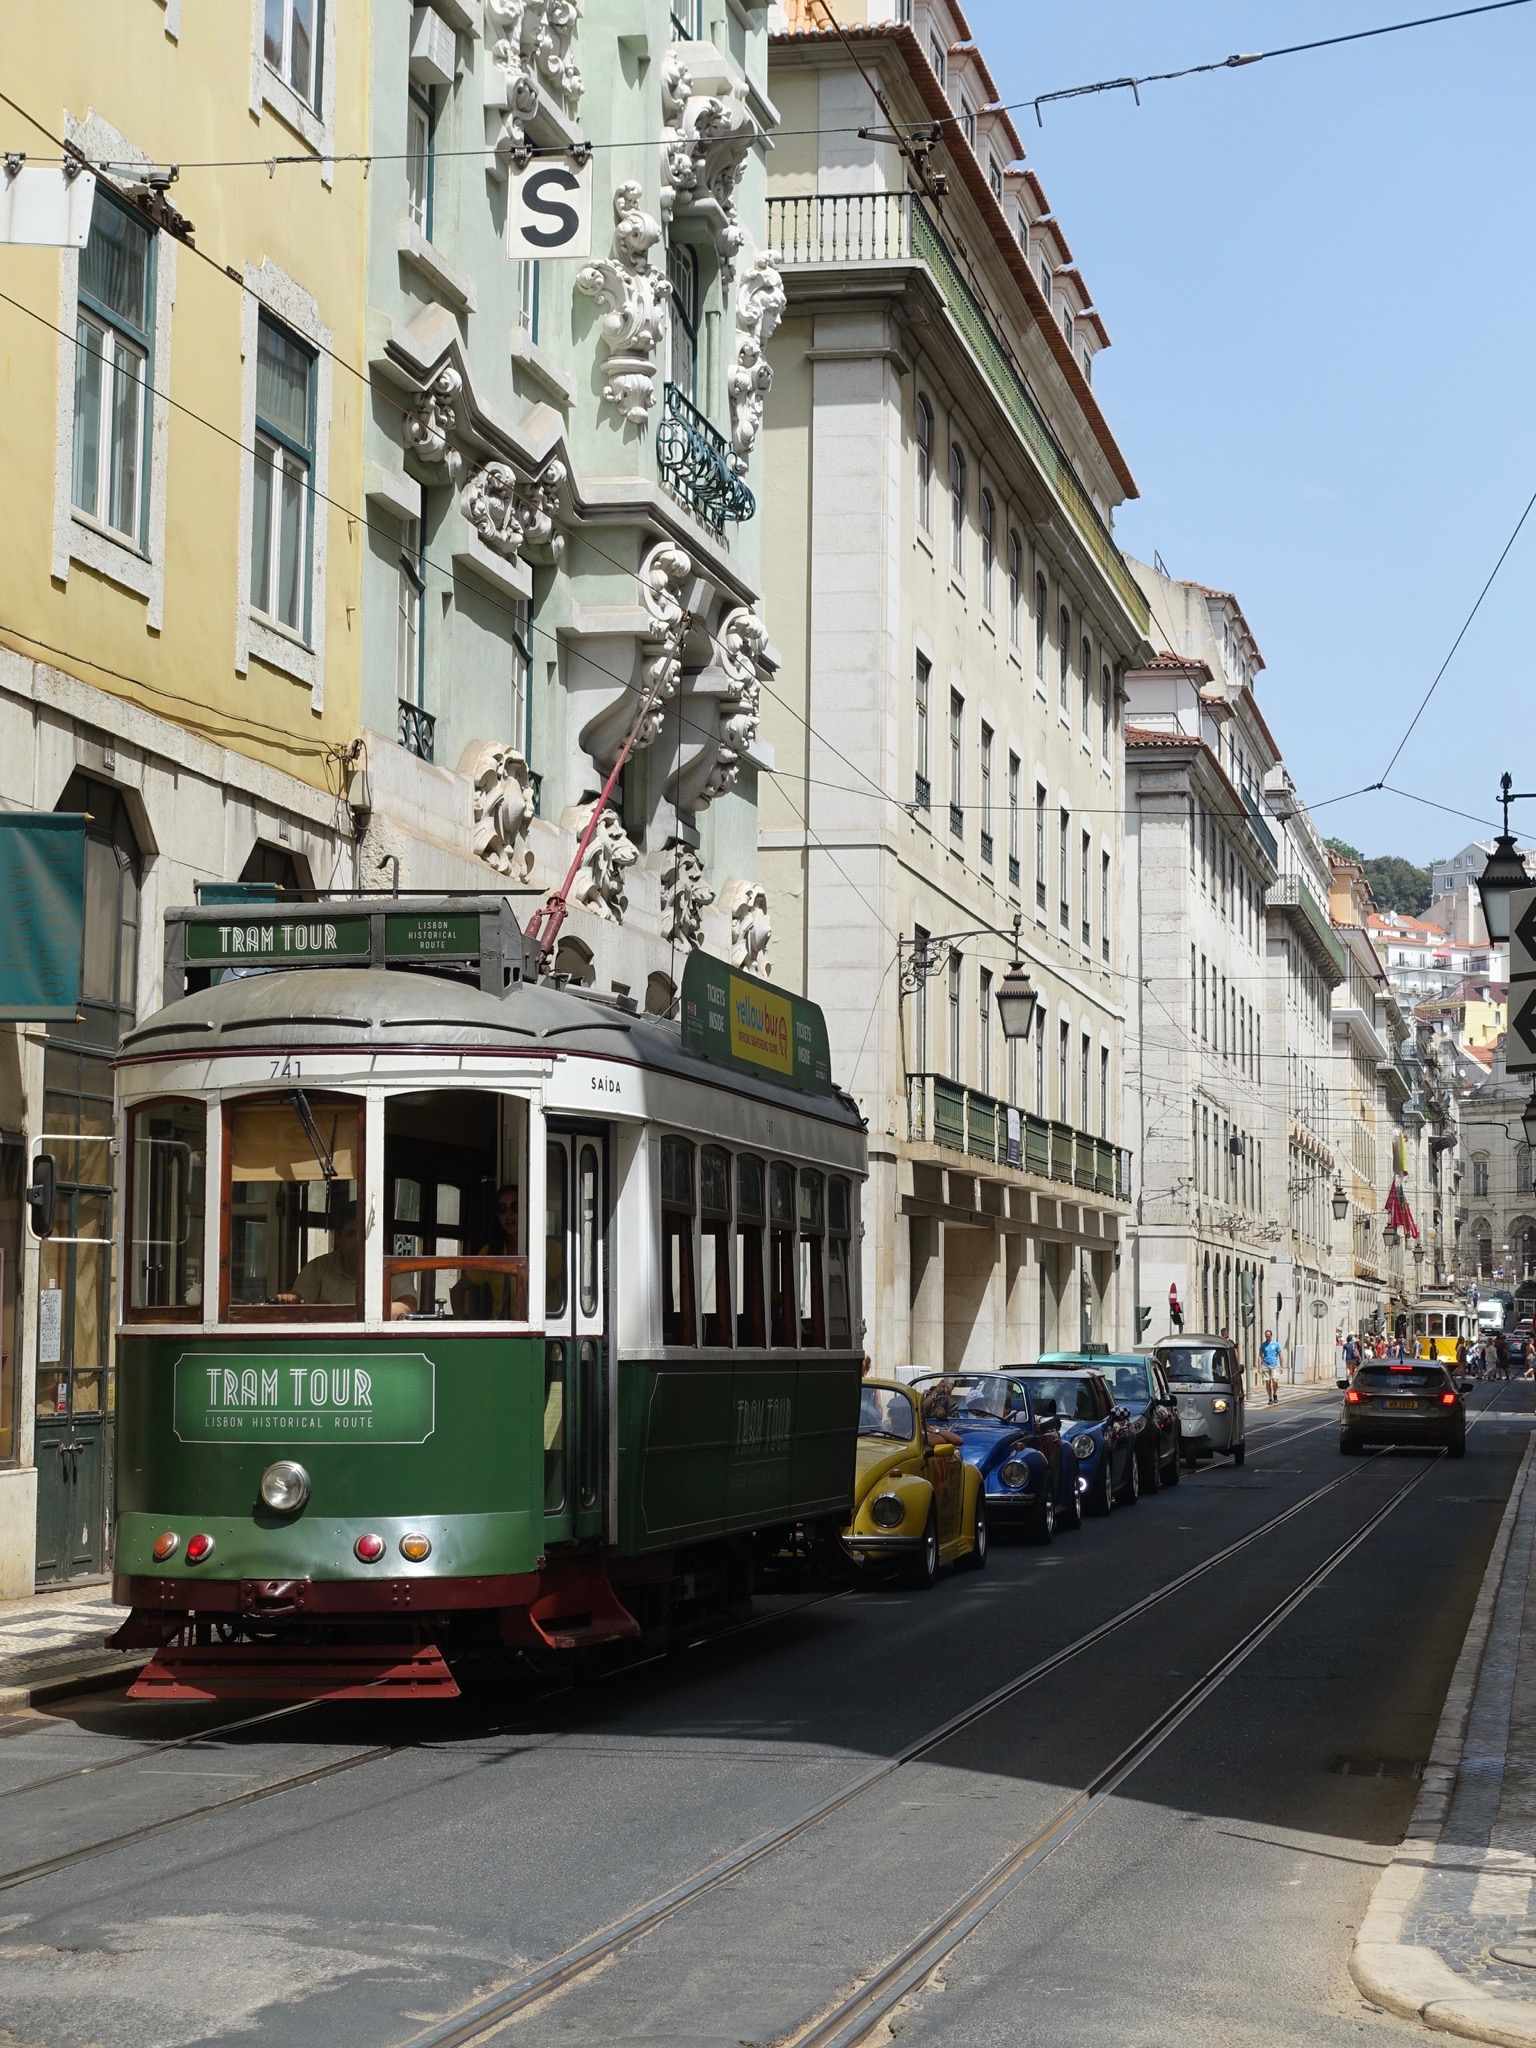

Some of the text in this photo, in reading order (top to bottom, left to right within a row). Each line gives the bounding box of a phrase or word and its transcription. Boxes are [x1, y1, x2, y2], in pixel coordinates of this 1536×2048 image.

[520, 168, 580, 248] S
[417, 921, 448, 930] LISBON
[218, 924, 338, 953] TRAM TOUR
[408, 931, 457, 940] HISTORICAL
[419, 941, 446, 949] ROUTE
[707, 983, 725, 1007] TICKETS
[708, 1010, 725, 1033] INSIDE
[796, 1021, 812, 1042] TICKETS
[797, 1046, 811, 1065] INSIDE
[270, 1061, 302, 1079] 741
[591, 1075, 622, 1094] SAÍDA
[206, 1368, 373, 1406] TRAM TOUR
[205, 1416, 373, 1428] LISBON HISTORICAL ROUTE
